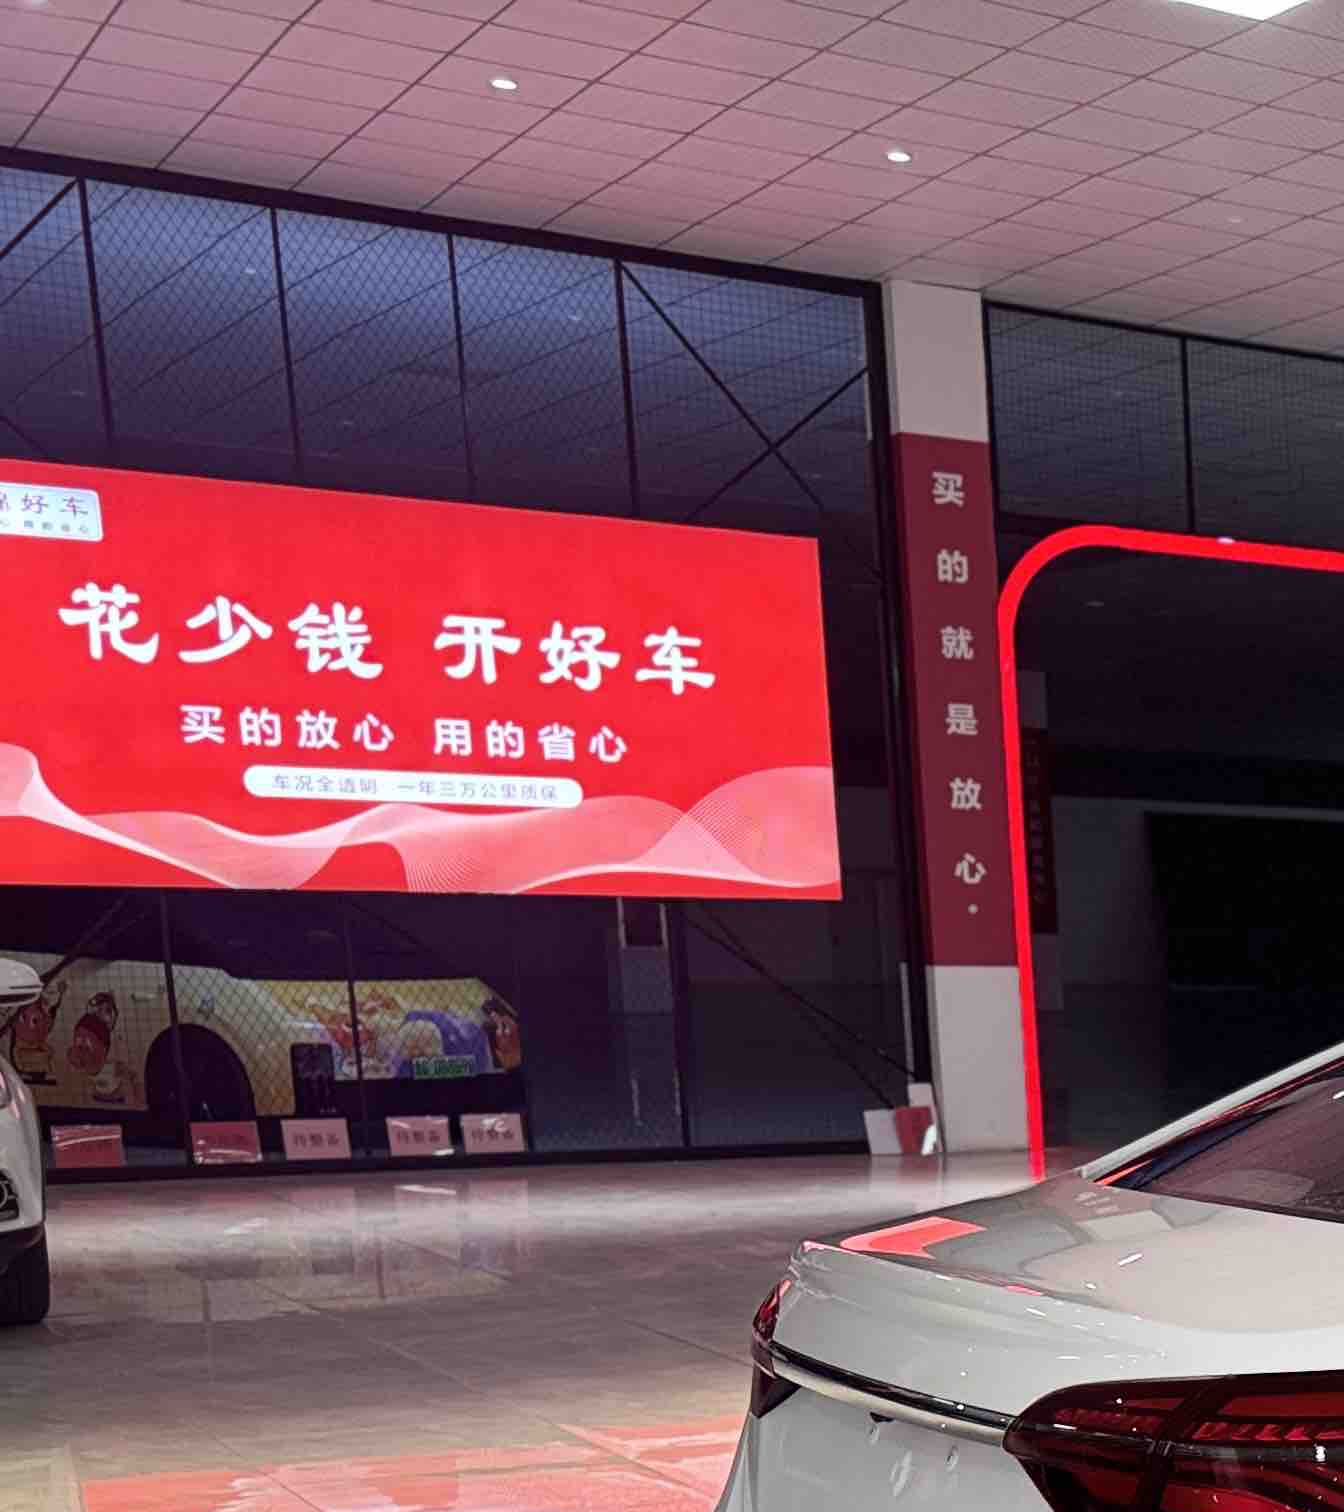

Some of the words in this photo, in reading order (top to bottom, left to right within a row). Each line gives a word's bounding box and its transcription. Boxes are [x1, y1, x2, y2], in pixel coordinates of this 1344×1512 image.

[58, 582, 385, 681] 花少钱
[433, 614, 717, 695] 开好车
[931, 471, 987, 885] 买的就是放心
[180, 704, 395, 752] 买的放心
[432, 719, 629, 764] 用的省心
[271, 774, 378, 796] 车况全透明
[396, 779, 559, 801] 一年三万公里质保
